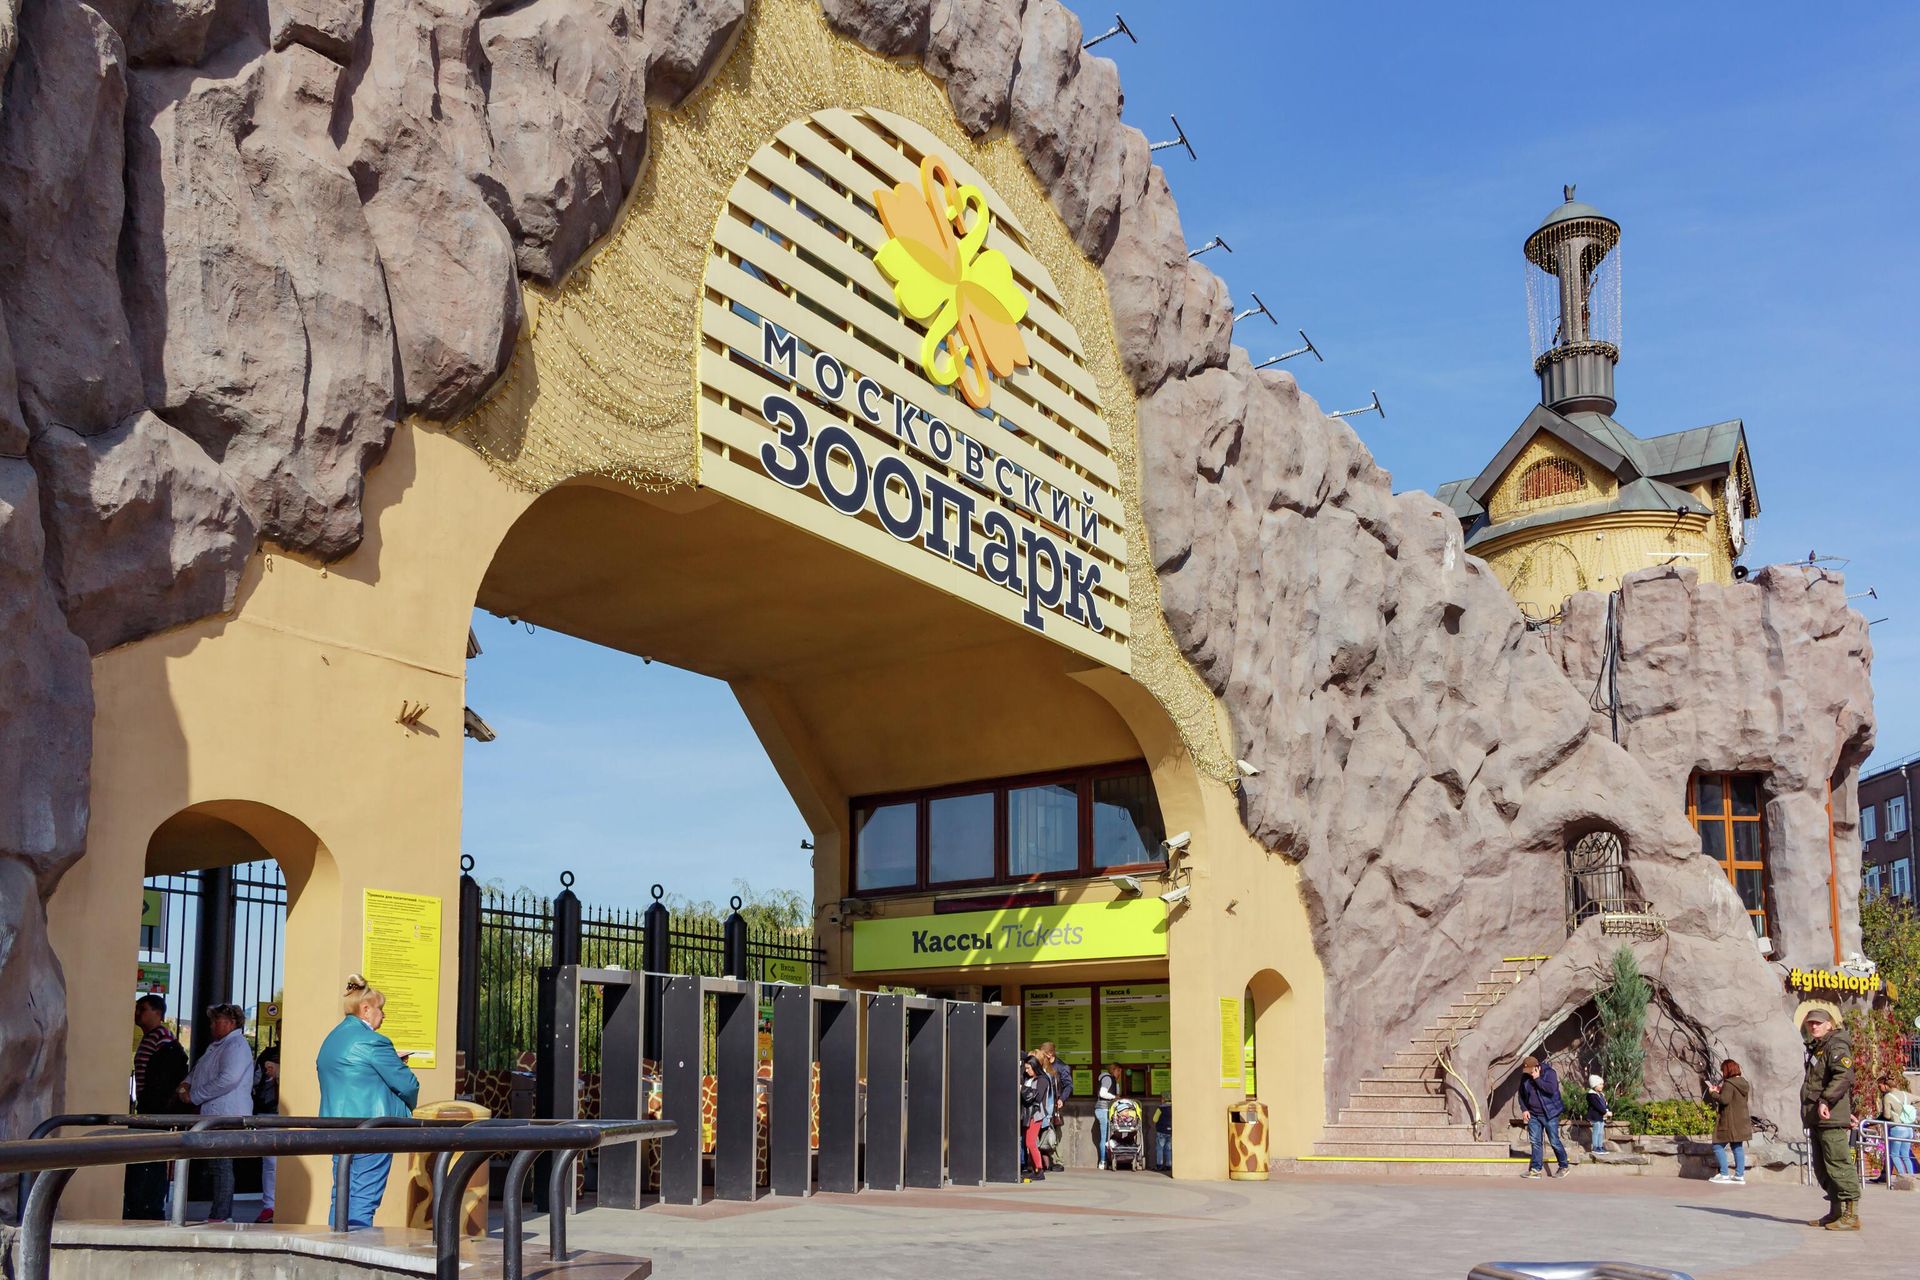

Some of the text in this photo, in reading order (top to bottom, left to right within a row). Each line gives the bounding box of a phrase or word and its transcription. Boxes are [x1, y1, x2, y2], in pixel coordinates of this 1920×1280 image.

[761, 317, 1099, 547] МОСКОВСКИЙ
[912, 923, 1084, 953] Кассы Tickets
[1791, 968, 1880, 994] #giftshop#
